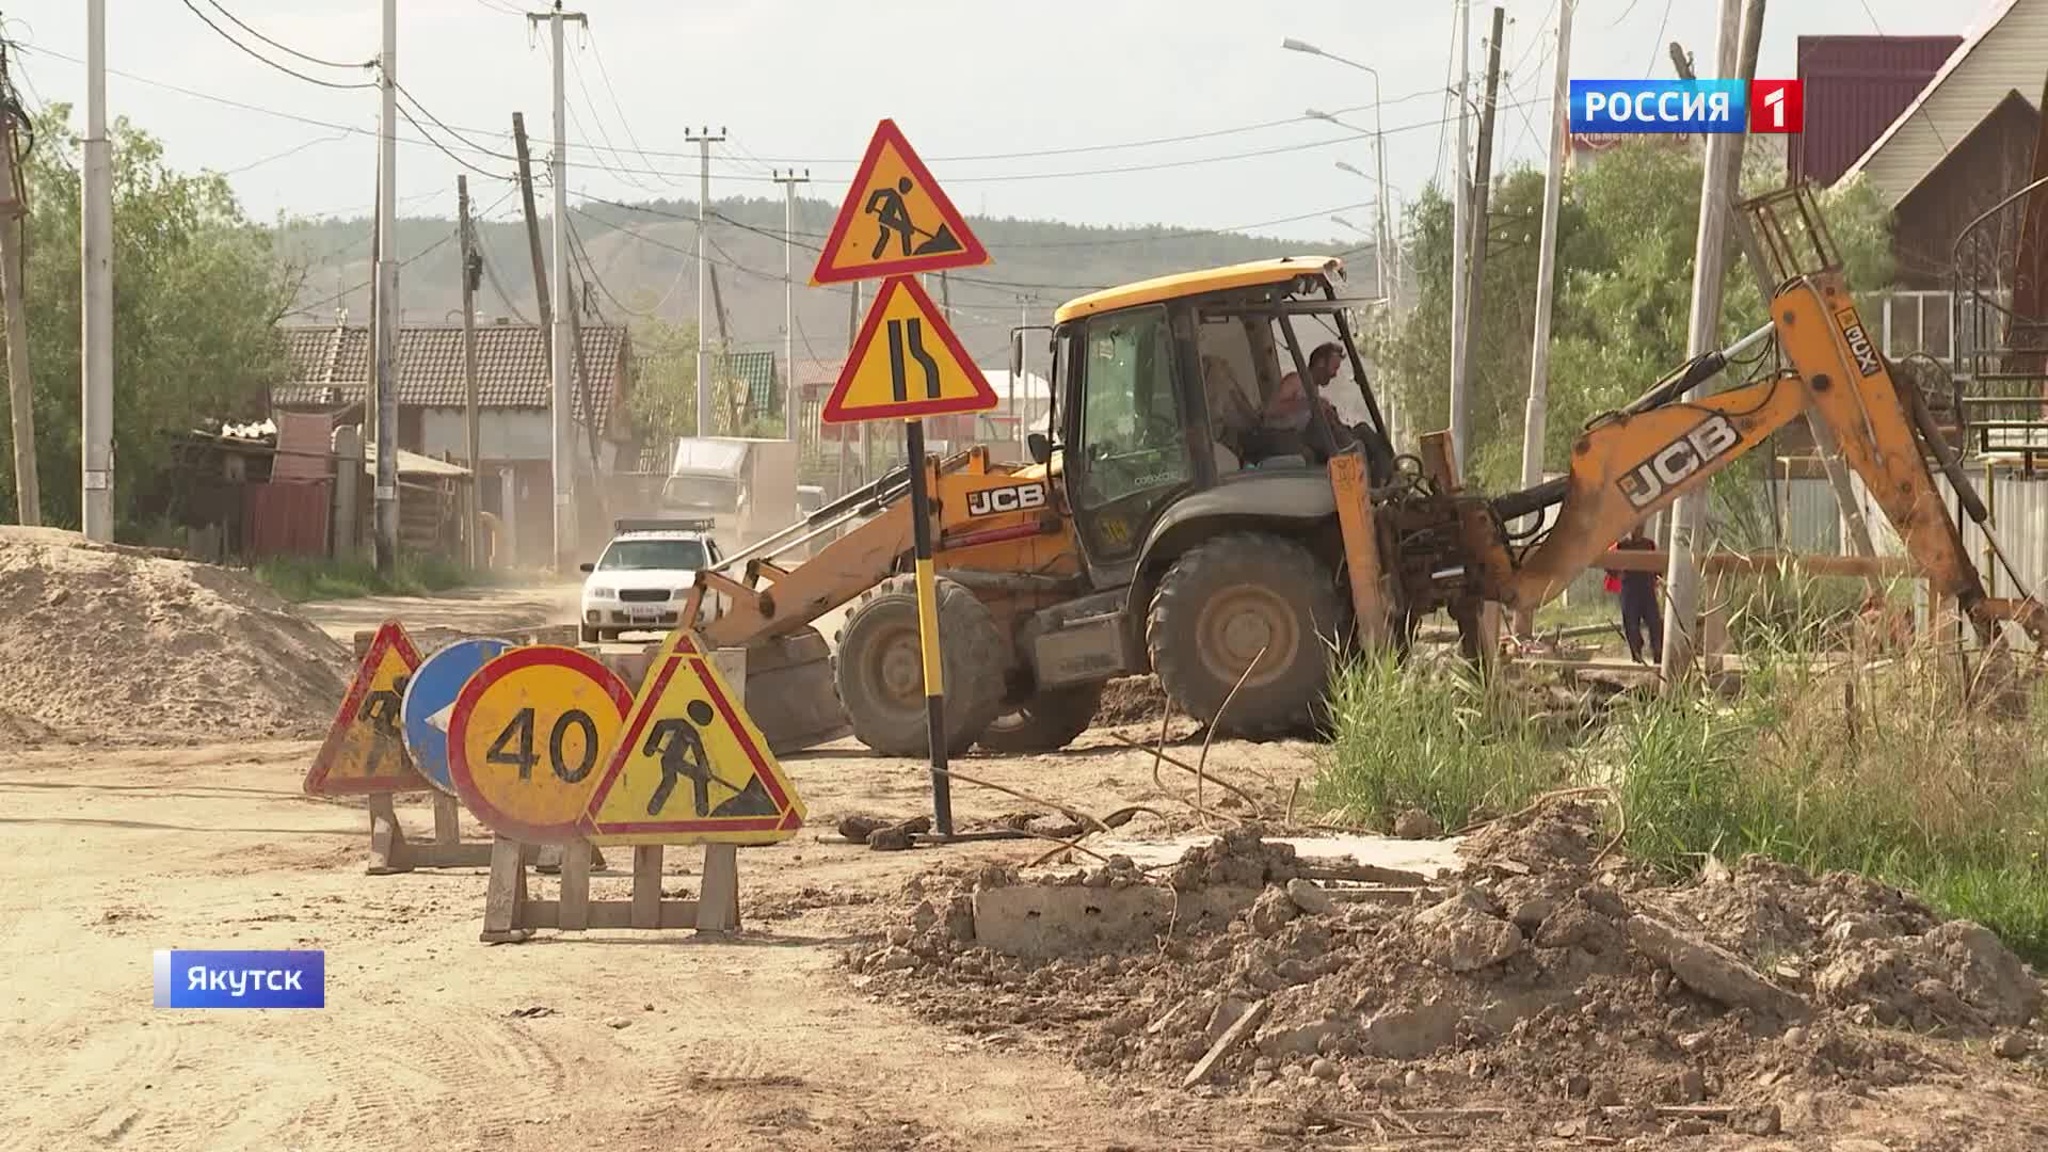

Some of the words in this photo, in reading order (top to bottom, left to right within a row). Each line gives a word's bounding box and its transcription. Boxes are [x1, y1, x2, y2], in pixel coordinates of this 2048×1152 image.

[1845, 325, 1878, 372] 3CX
[1627, 415, 1738, 507] JCB
[968, 483, 1046, 515] JCB
[486, 707, 599, 784] 40
